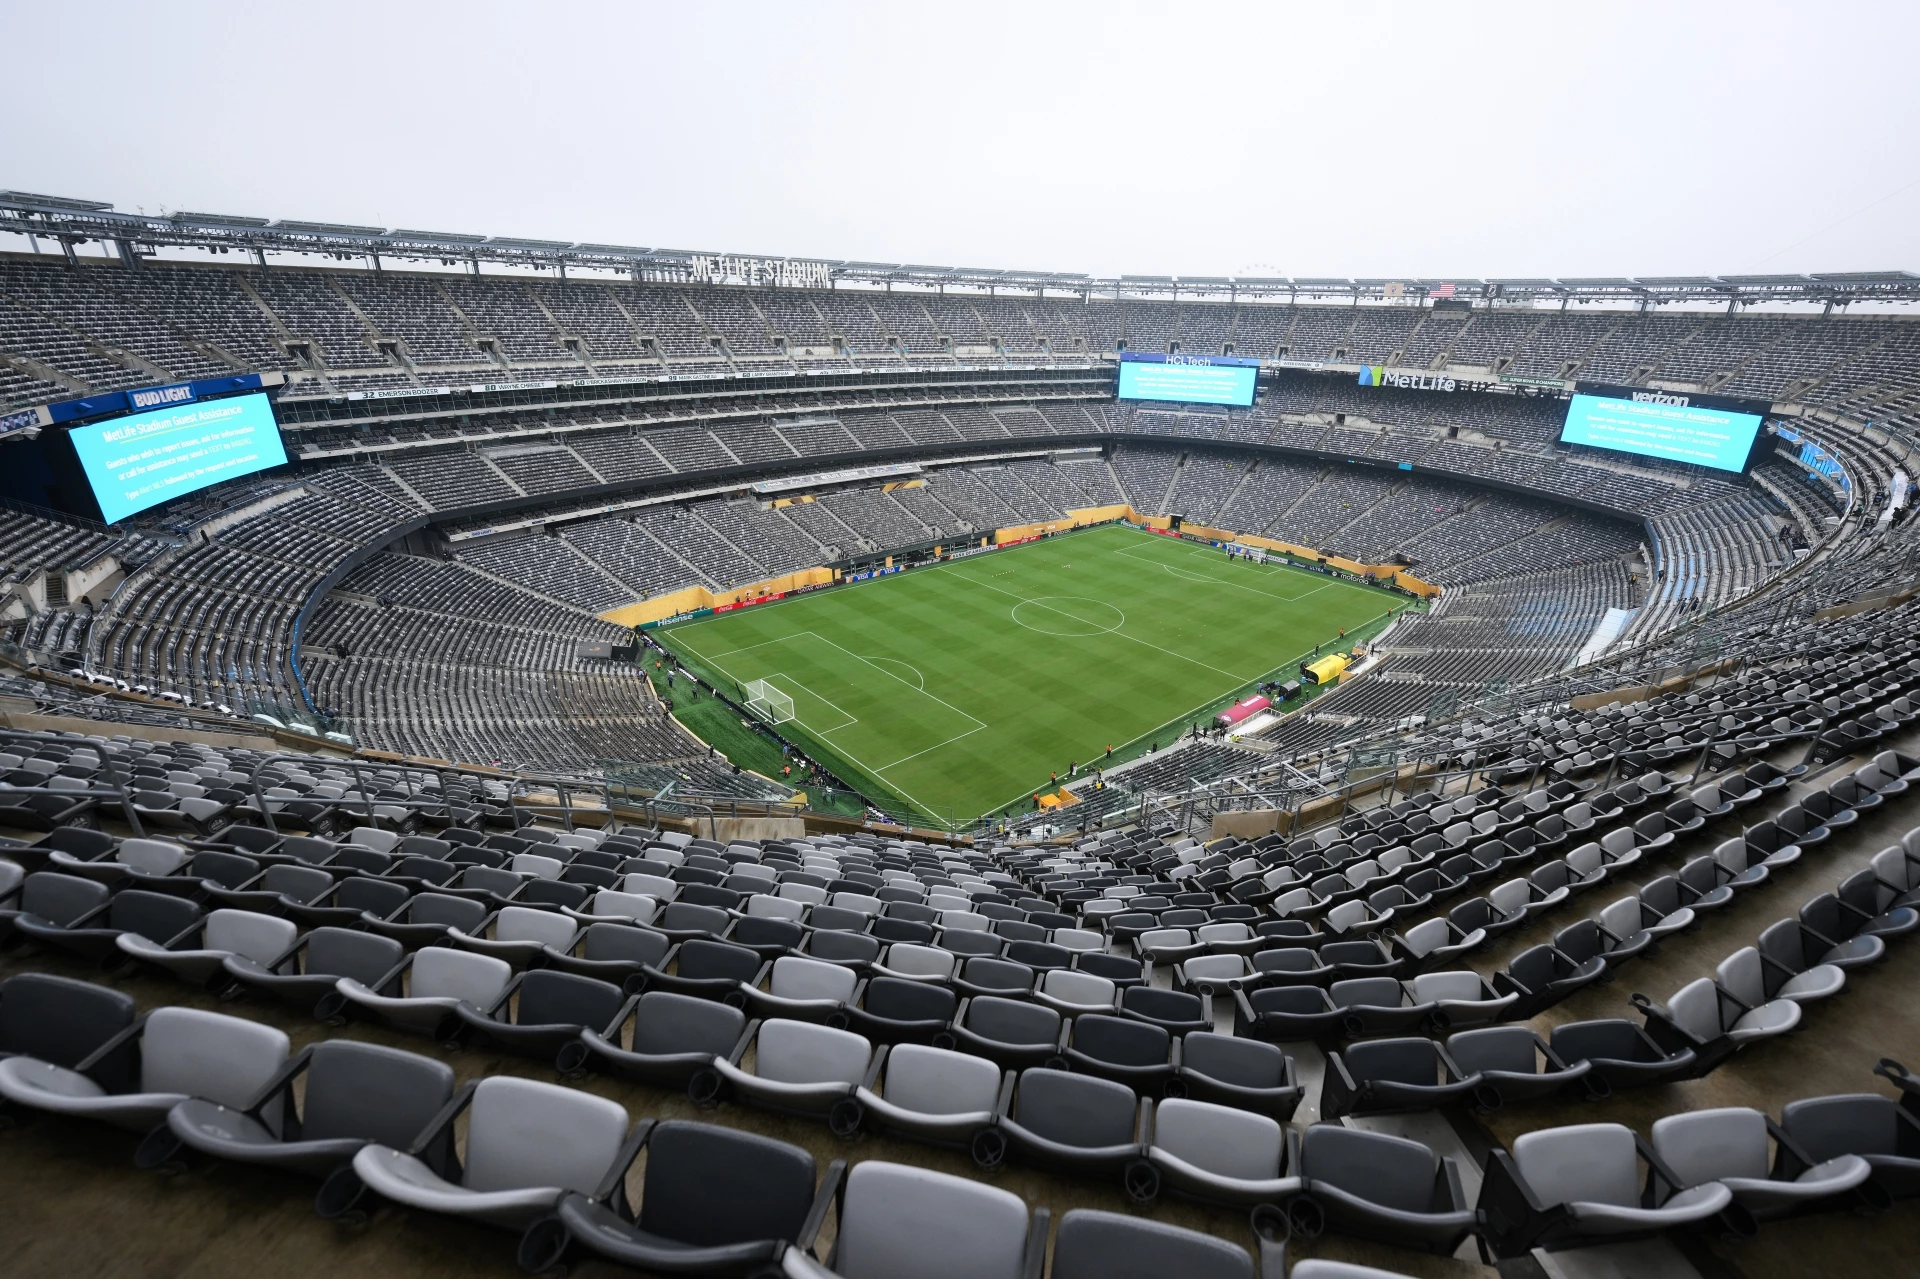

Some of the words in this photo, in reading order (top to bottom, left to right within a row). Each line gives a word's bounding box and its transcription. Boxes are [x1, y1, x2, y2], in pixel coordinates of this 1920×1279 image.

[691, 255, 759, 279] METLIFE
[764, 259, 829, 283] STADIUM
[1166, 355, 1211, 367] HCLTech
[1382, 370, 1456, 392] MetLife
[133, 391, 160, 407] BUD
[158, 386, 193, 403] LIGHT
[378, 390, 411, 398] EMERSON
[412, 388, 439, 396] BOOZER
[1632, 391, 1689, 408] verizon
[1597, 401, 1627, 411] MetLife
[1628, 405, 1660, 416] Stadium
[1661, 409, 1685, 419] Guest
[1686, 412, 1731, 425] Assistance
[102, 425, 137, 443] MetLife
[136, 419, 173, 434] Stadium
[172, 413, 198, 426] Guest
[198, 406, 243, 421] Assistance
[162, 443, 180, 453] report
[125, 490, 139, 501] Type
[857, 573, 869, 581] VISA
[1340, 573, 1369, 585] motorola
[797, 586, 814, 594] QATAR
[657, 613, 694, 627] Hisense
